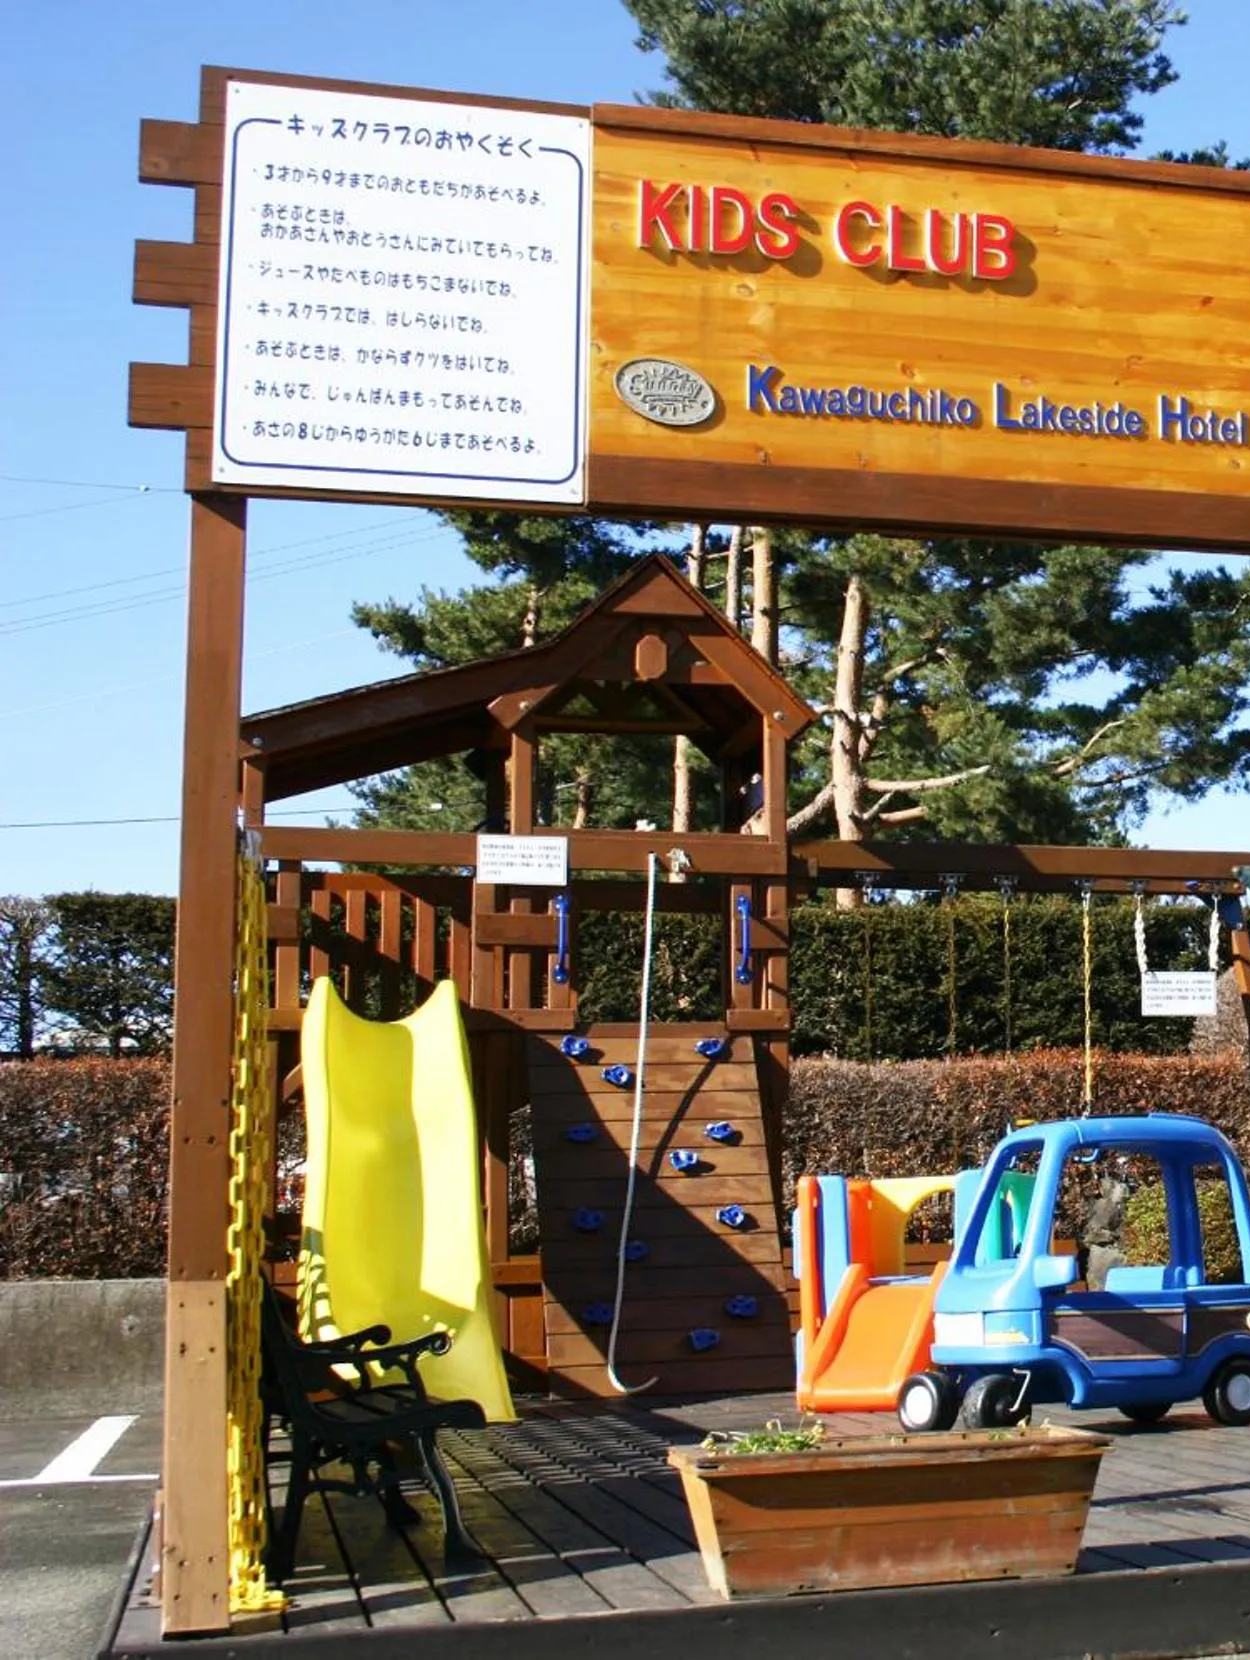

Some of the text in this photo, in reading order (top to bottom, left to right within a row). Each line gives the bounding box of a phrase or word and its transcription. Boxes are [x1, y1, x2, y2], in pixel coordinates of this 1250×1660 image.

[286, 113, 532, 158] キッズクラブのおやくそく
[640, 179, 1017, 280] KIDS CLUB
[747, 364, 1250, 446] Kawaguchiko Lakeside Hotel
